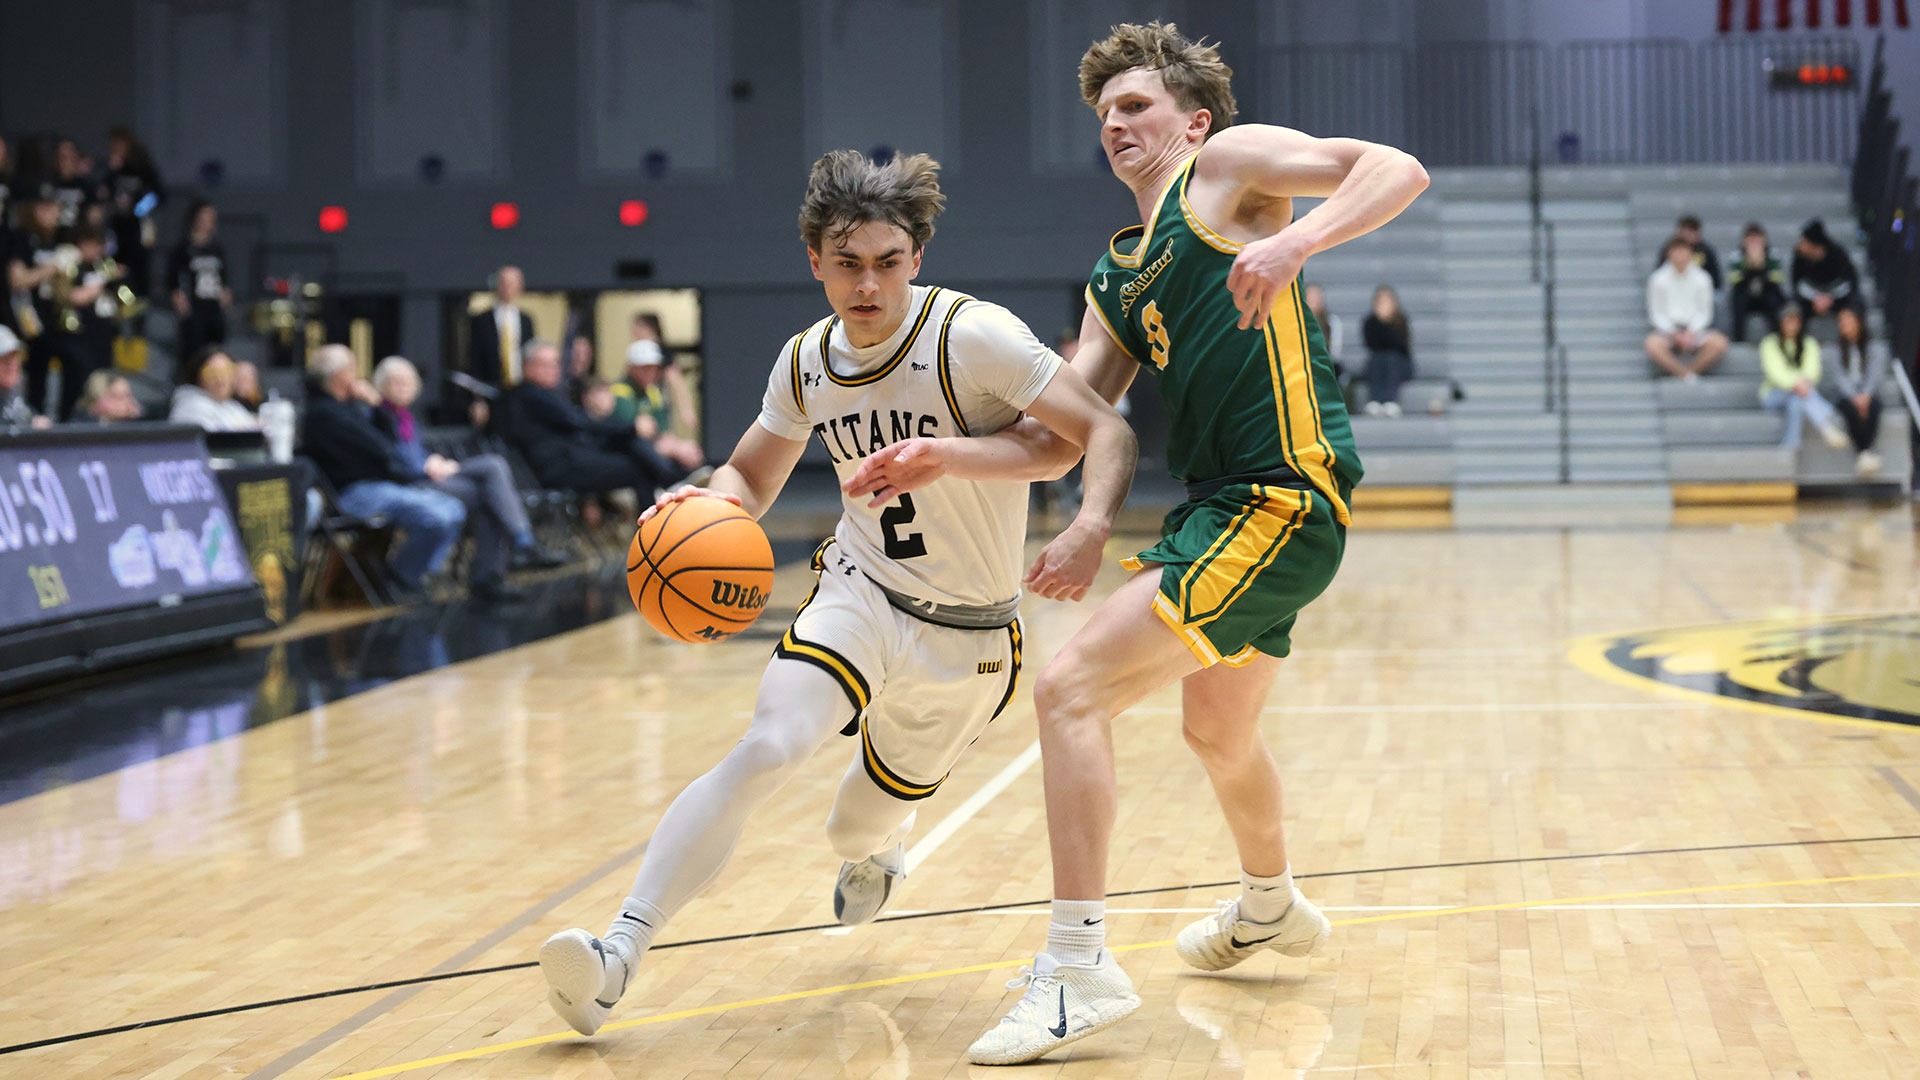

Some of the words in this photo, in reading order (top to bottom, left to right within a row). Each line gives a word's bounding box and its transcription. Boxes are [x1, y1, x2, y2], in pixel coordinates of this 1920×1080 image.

[812, 409, 939, 464] TITANS
[0, 459, 77, 552] 0:50
[873, 487, 928, 560] 2
[711, 579, 771, 609] Wilso
[977, 659, 1002, 674] UW
